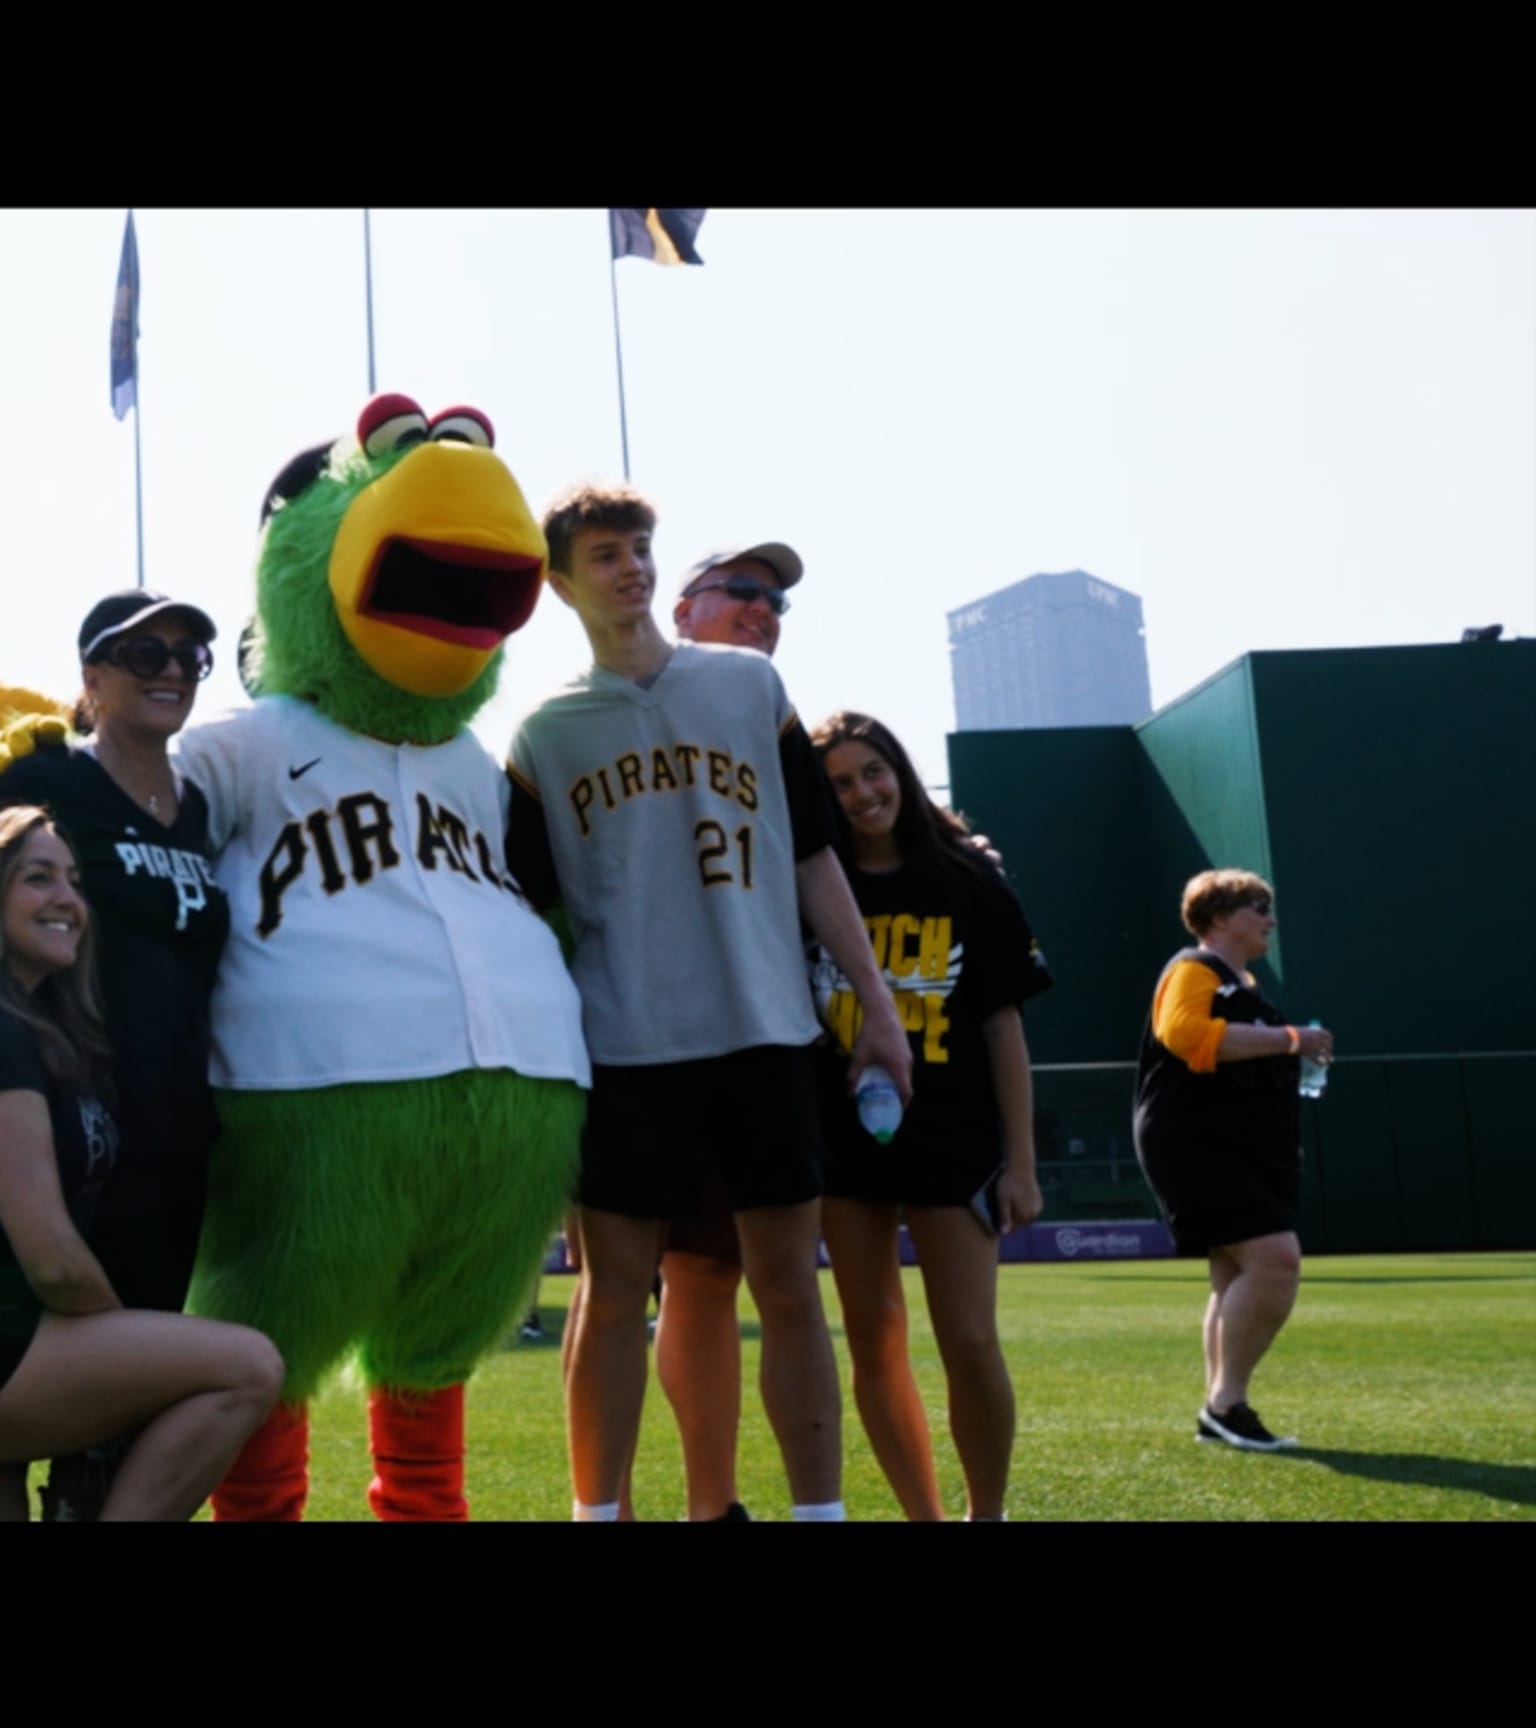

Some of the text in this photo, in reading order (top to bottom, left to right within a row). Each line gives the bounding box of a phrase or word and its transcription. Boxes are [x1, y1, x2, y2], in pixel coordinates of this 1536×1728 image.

[569, 744, 759, 837] PIRATES
[113, 841, 218, 887] PIRATE
[255, 790, 525, 940] PIRAT
[694, 819, 754, 890] 21
[863, 913, 952, 981] TCH
[826, 985, 949, 1063] HPE
